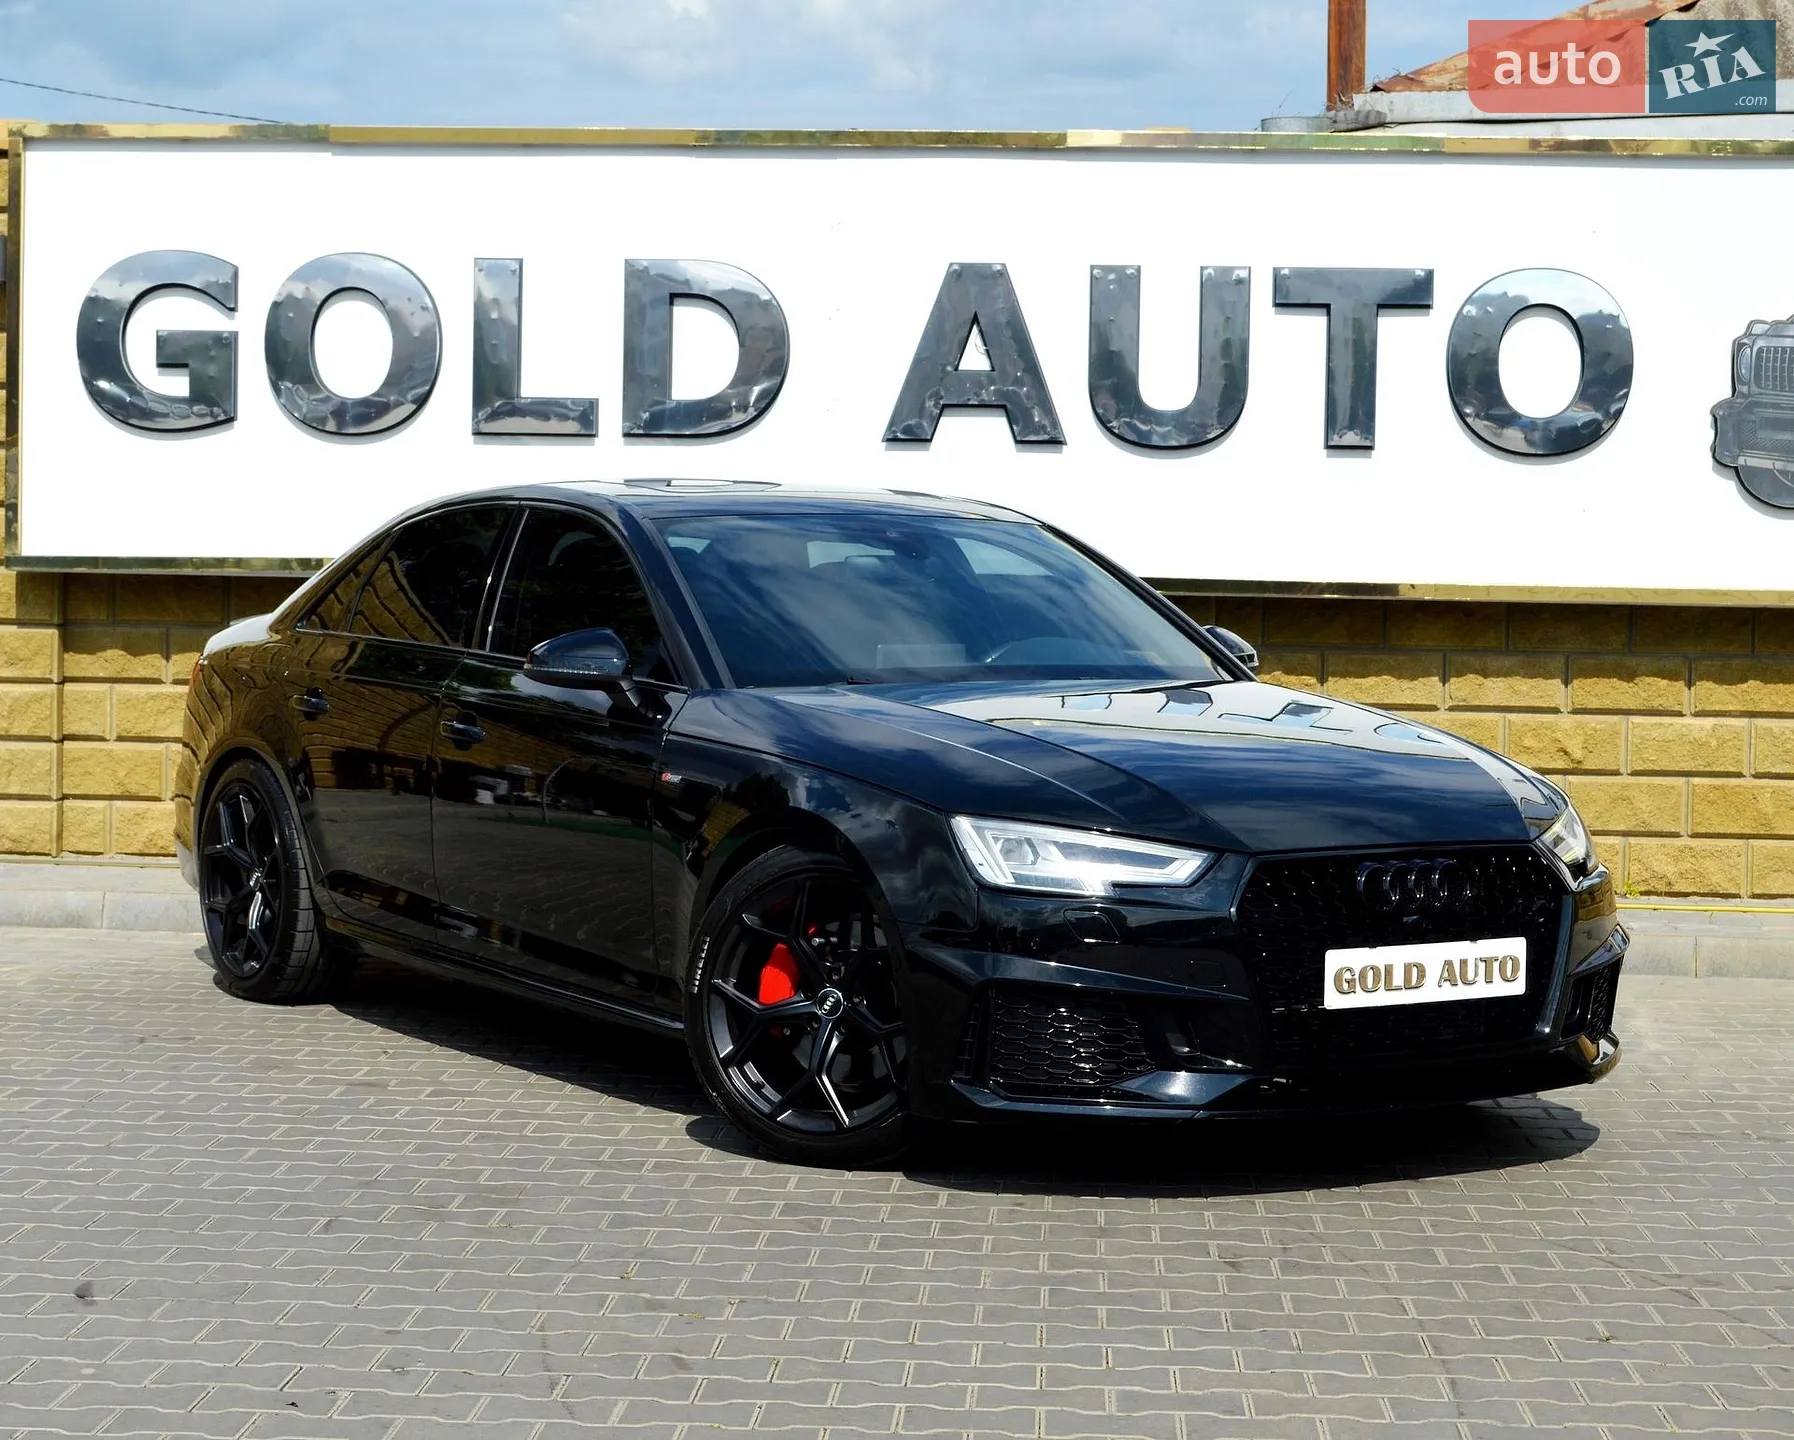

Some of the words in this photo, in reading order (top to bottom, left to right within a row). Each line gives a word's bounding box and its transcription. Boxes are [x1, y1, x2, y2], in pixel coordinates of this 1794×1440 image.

[76, 249, 791, 437] GOLD
[881, 262, 1635, 459] AUTO
[1333, 962, 1427, 994] GOLD
[1437, 954, 1521, 988] AUTO
